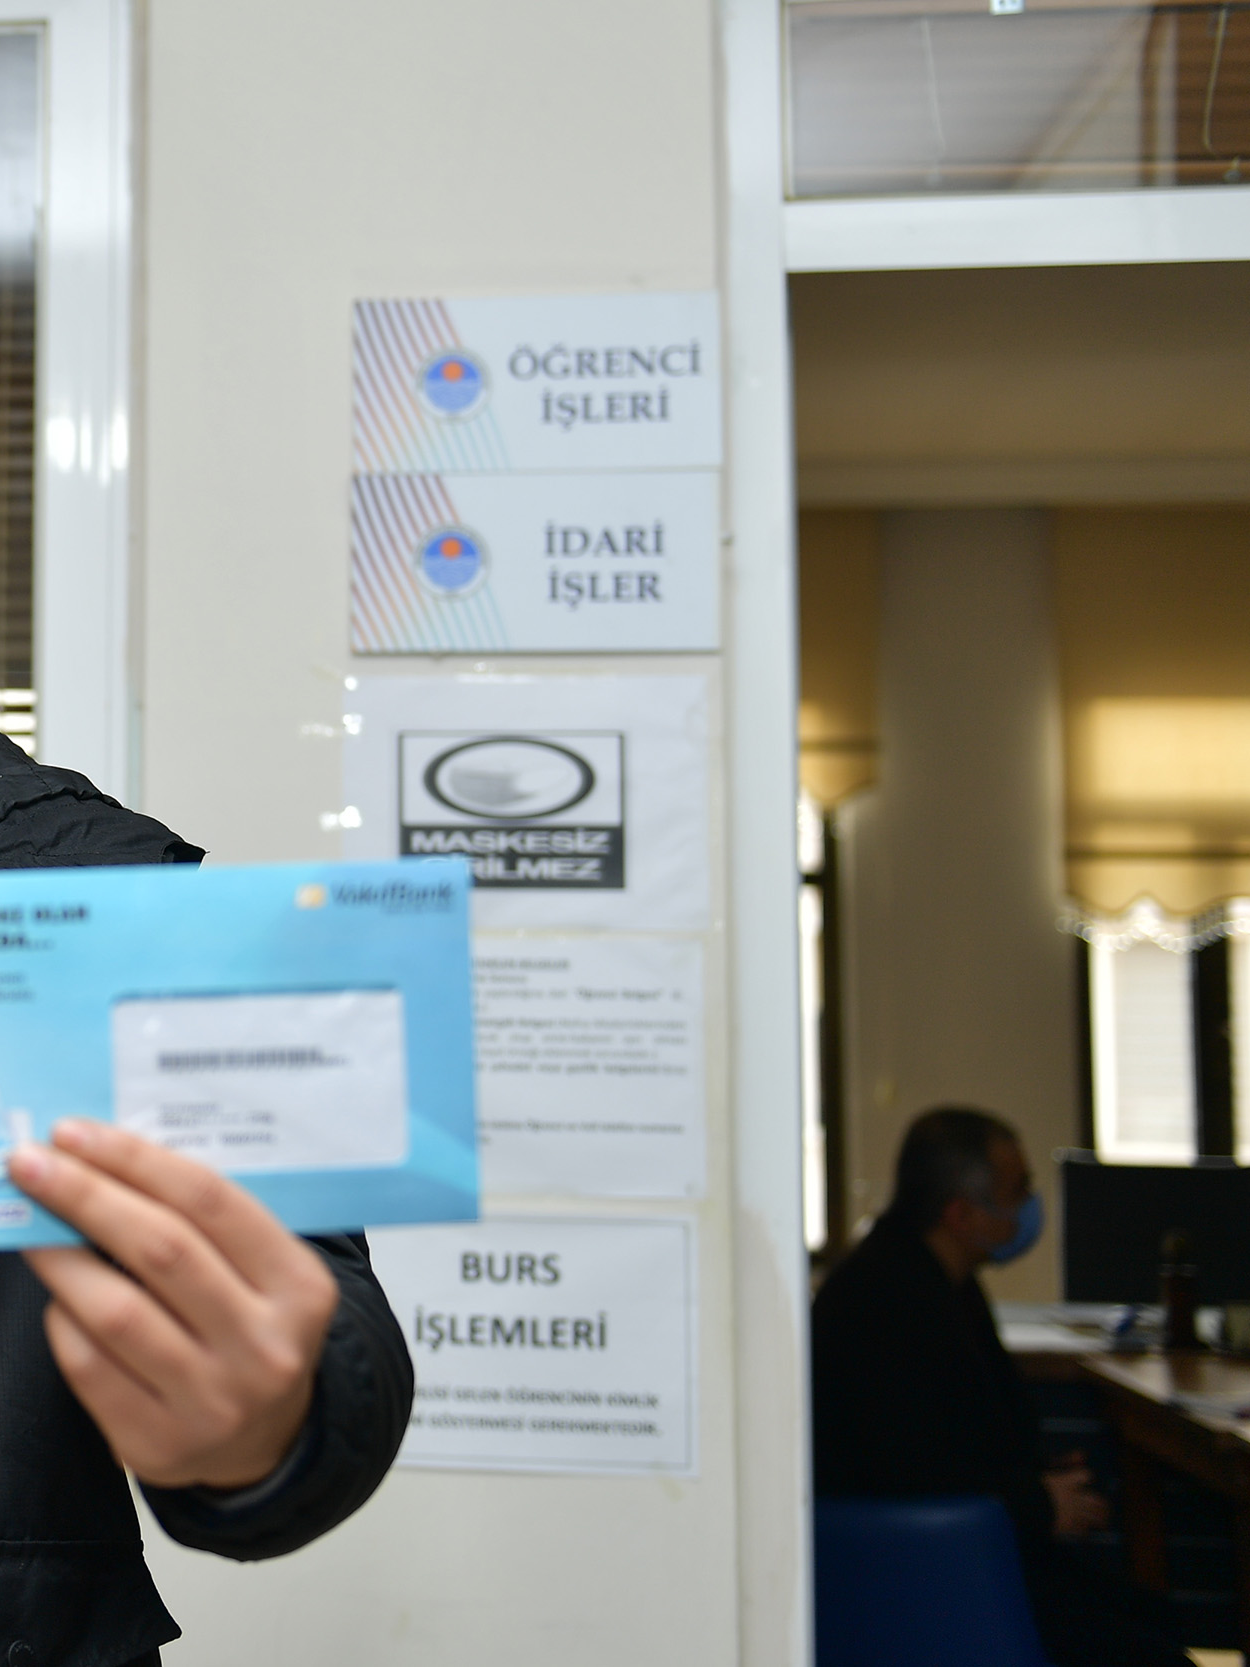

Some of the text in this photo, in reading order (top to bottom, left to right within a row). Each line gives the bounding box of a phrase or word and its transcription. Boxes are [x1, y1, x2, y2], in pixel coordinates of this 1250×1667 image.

[507, 338, 702, 381] ÖĞRENCİ
[541, 389, 670, 431] İŞLERİ
[544, 520, 664, 558] İDARİ
[548, 566, 662, 611] İŞLER
[409, 828, 611, 855] MASKESİZ
[424, 854, 602, 881] RİLMEZ
[460, 1251, 561, 1284] BURS
[414, 1304, 608, 1352] İŞLEMLERİ
